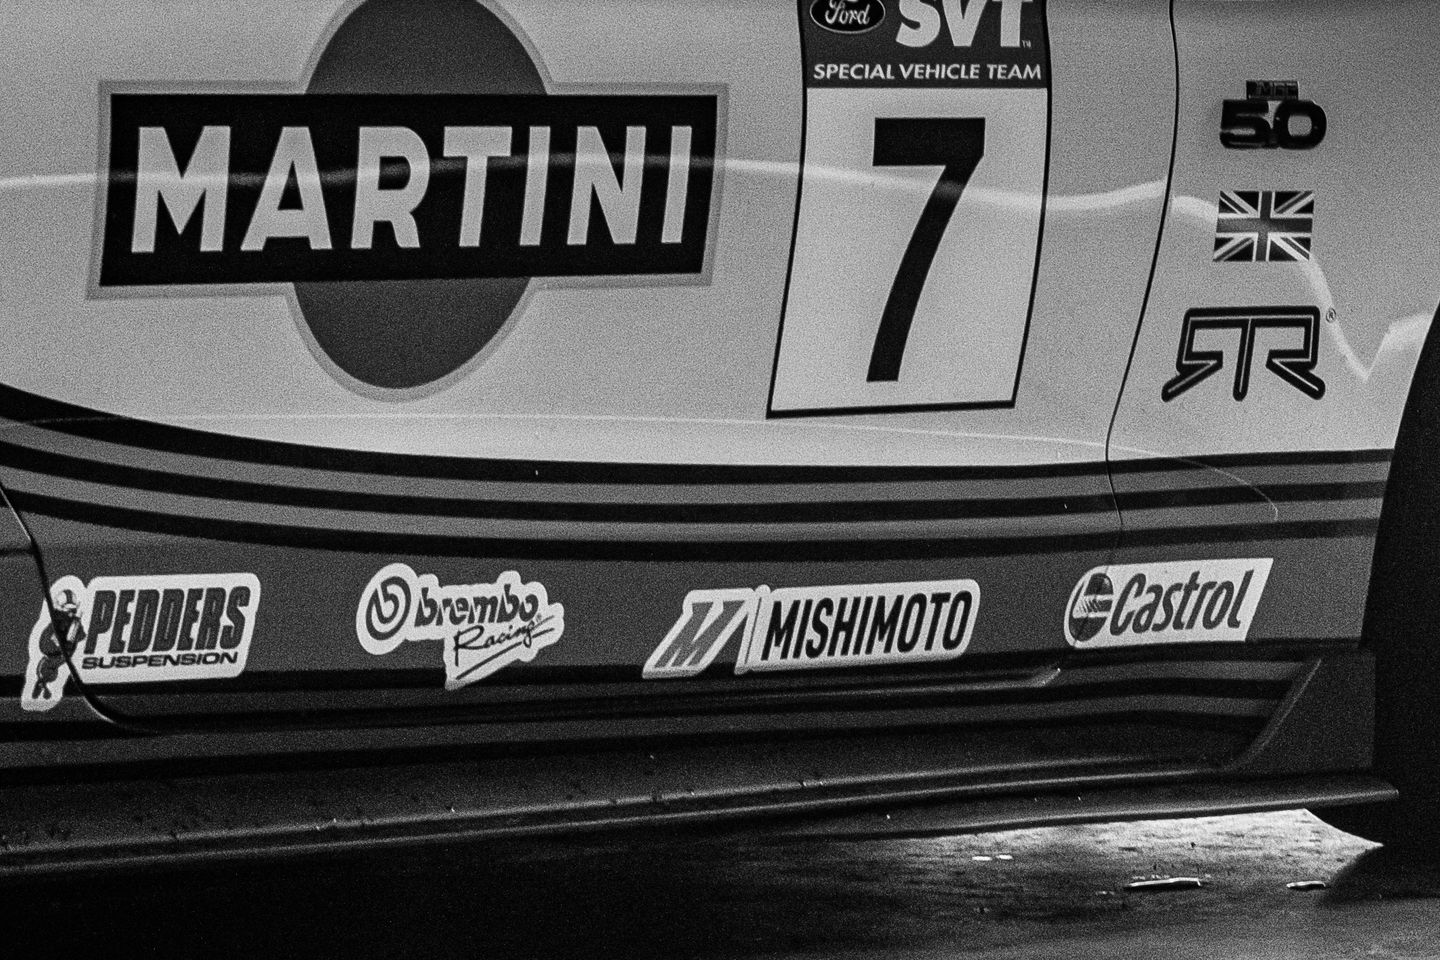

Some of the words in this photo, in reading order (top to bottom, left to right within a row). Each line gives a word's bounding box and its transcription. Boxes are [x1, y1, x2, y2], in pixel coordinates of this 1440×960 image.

[812, 62, 895, 80] SPECIAL
[899, 63, 981, 80] VEHICLE
[986, 63, 1042, 80] TEAM
[131, 124, 693, 253] MARTINI
[866, 117, 986, 382] 7
[83, 586, 251, 655] PEDDERS
[414, 583, 539, 628] brembo
[760, 590, 973, 662] MISHIMOTO
[1109, 569, 1255, 637] Castrol
[81, 651, 239, 670] SUSPENSION
[453, 620, 537, 668] Racing
